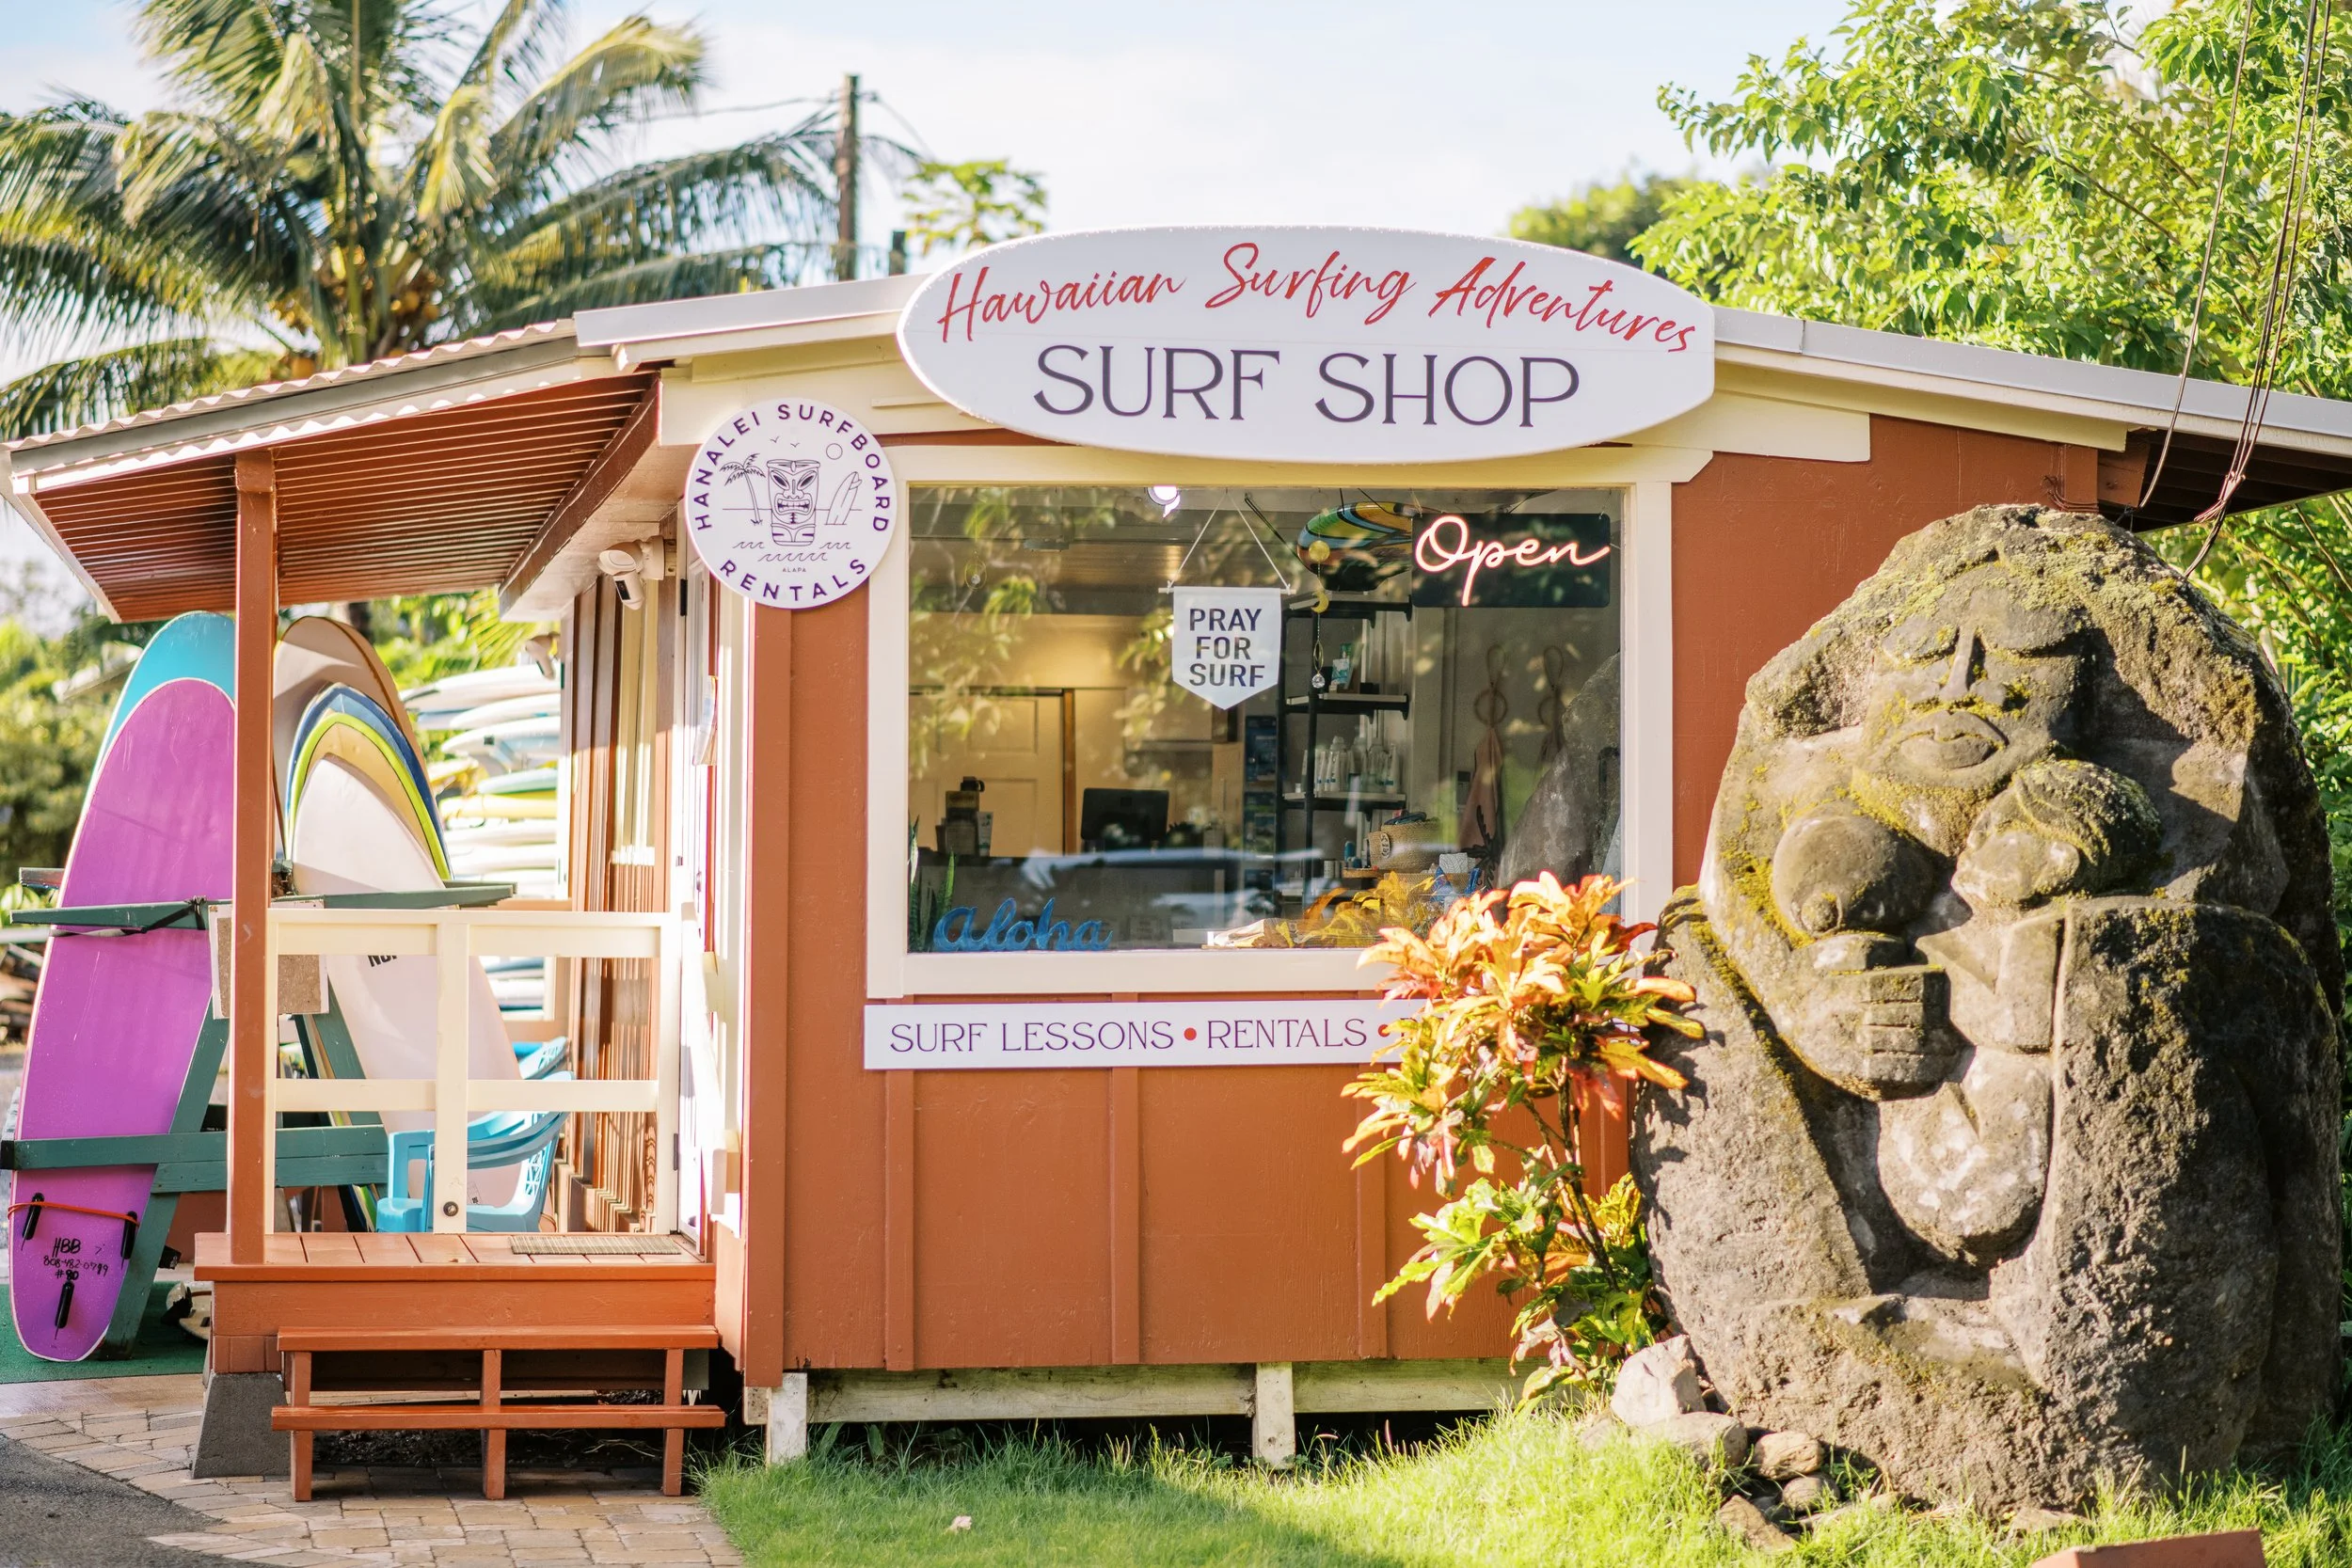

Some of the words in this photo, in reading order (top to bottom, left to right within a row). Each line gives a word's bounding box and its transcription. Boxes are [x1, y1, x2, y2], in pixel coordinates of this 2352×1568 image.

[937, 266, 1185, 342] Hawaiian
[1205, 242, 1416, 325] Surfing
[1427, 256, 1696, 354] Adventures
[1033, 344, 1280, 420] SURF
[1314, 352, 1580, 428] SHOP
[693, 411, 761, 531] HANALEI
[777, 404, 891, 532] SURFBOARD
[720, 559, 866, 601] RENTALS
[1415, 515, 1611, 607] Open
[1189, 608, 1263, 632] PRAY
[1196, 636, 1251, 660] FOR
[1189, 662, 1265, 688] SURF
[933, 897, 1113, 951] Aloha
[890, 1022, 988, 1053] SURF
[1002, 1021, 1174, 1052] LESSONS
[1207, 1018, 1367, 1049] RENTALS
